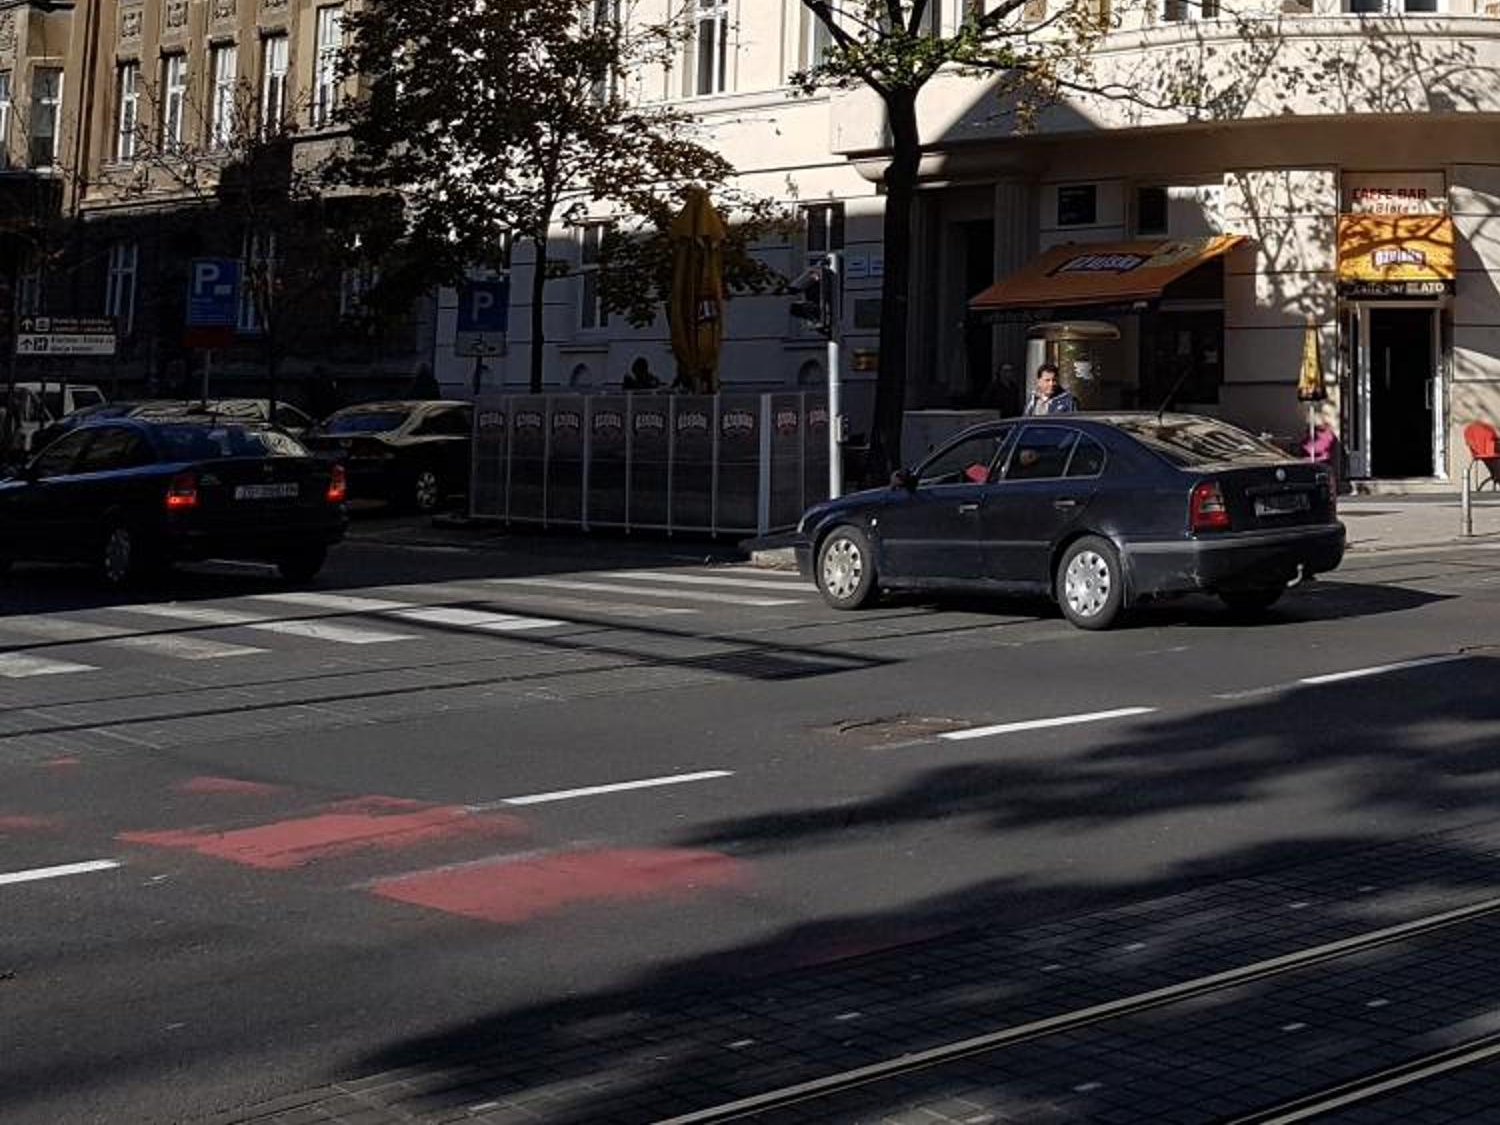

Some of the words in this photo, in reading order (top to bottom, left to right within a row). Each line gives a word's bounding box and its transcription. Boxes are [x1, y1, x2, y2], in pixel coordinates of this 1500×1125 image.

[1398, 188, 1427, 200] BAR
[196, 263, 220, 294] P
[472, 291, 494, 322] P
